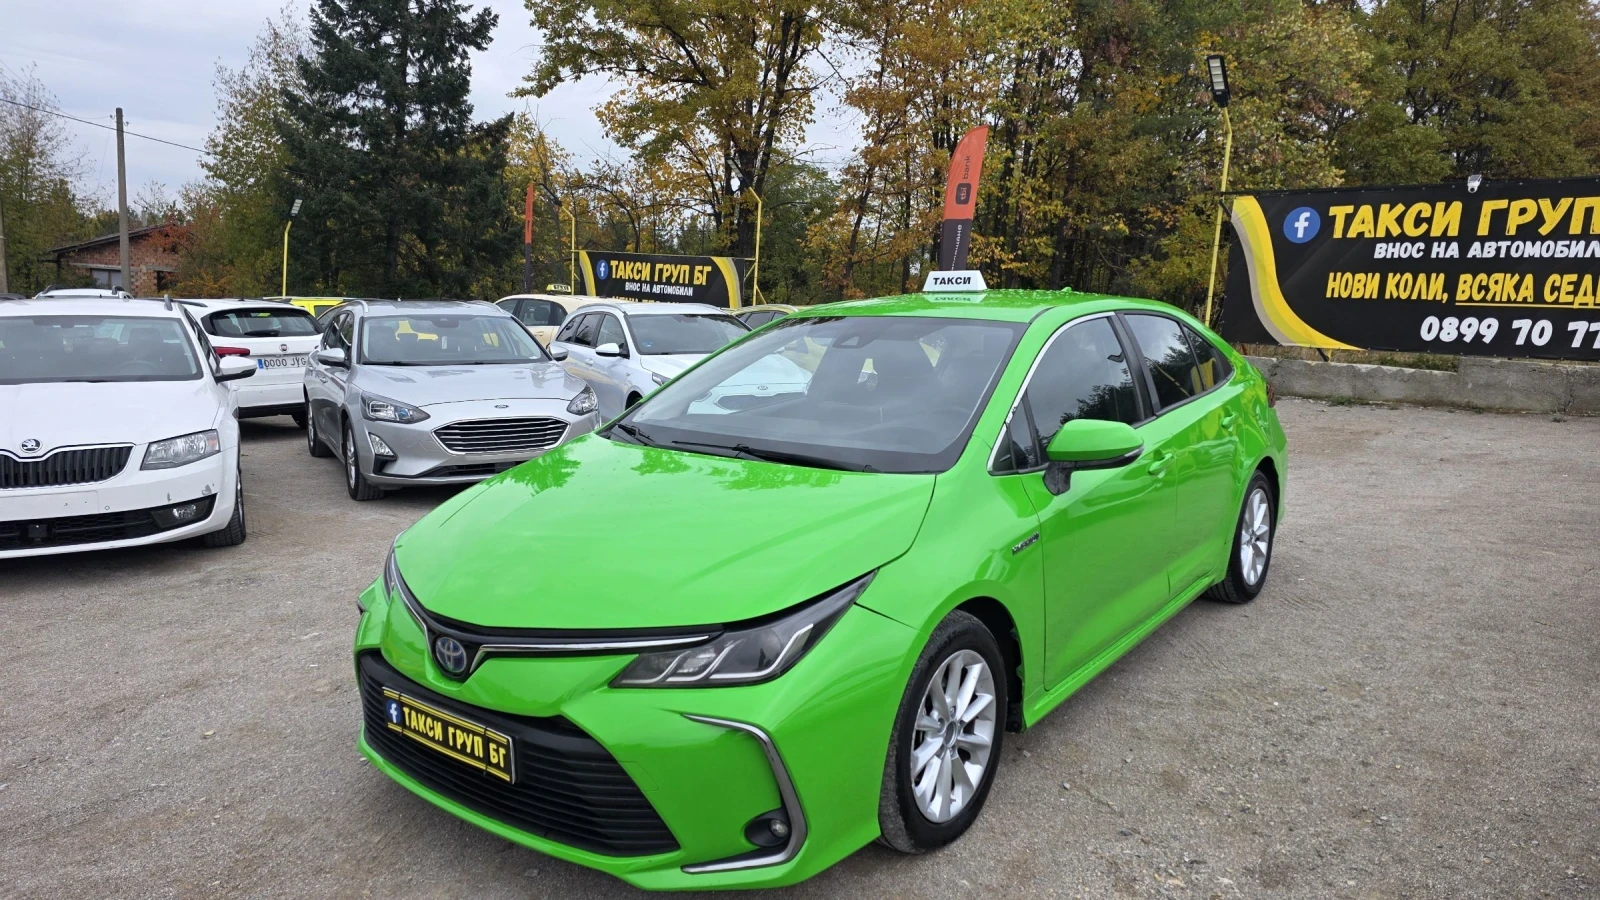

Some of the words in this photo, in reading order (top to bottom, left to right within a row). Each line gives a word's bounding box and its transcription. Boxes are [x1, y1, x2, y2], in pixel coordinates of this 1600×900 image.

[1329, 201, 1463, 238] ТАКСИ
[1477, 196, 1600, 236] ГРУП
[1374, 242, 1425, 259] ВНОС
[1431, 241, 1459, 258] НА
[1467, 240, 1600, 258] АВТОМОБИЛ
[610, 260, 651, 281] ТАКСИ
[654, 263, 690, 284] ГРУП
[693, 265, 712, 285] БГ
[933, 277, 971, 285] ТАКСИ
[625, 282, 641, 292] ВНОС
[642, 283, 651, 293] НА
[652, 284, 693, 297] АВТОМОБИЛИ
[1326, 272, 1380, 299] НОВИ
[1385, 272, 1448, 303] КОЛИ,
[1456, 272, 1534, 302] ВСЯКА
[1544, 273, 1600, 309] СЕД
[1420, 315, 1499, 344] 0899
[1512, 318, 1553, 346] 70
[403, 706, 443, 741] ТАКСИ
[448, 726, 483, 758] ГРУП
[489, 742, 506, 768] БГ
